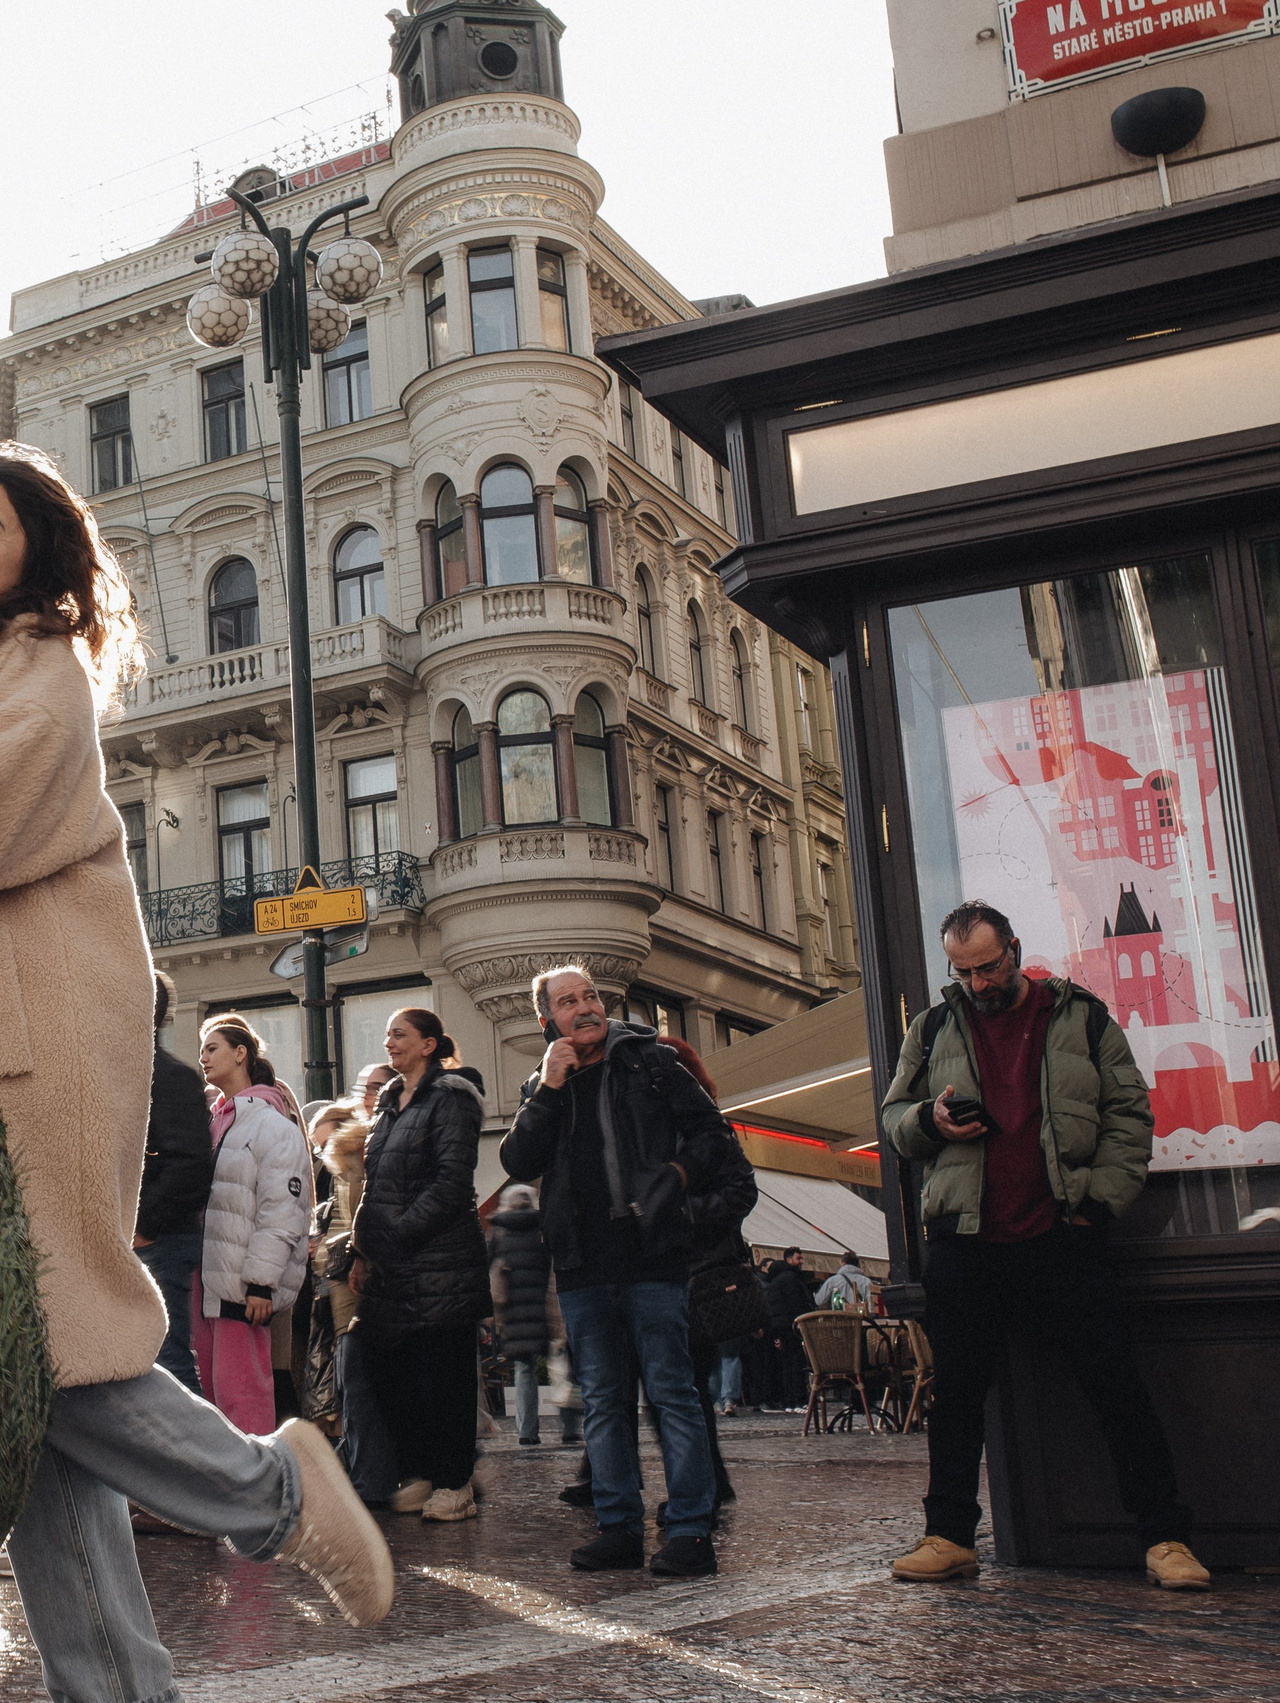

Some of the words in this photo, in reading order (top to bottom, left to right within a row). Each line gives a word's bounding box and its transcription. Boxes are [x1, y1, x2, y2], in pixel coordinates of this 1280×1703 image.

[1046, 0, 1087, 35] NA
[1053, 29, 1099, 60] STARÉ
[1103, 1, 1217, 46] MĚSTO-PRAHA
[1219, 0, 1227, 15] 1
[264, 905, 269, 914] A
[270, 904, 278, 914] 24
[289, 899, 318, 912] SMÍCHOV
[350, 894, 356, 904] 2
[290, 912, 310, 924] ÚJEZD
